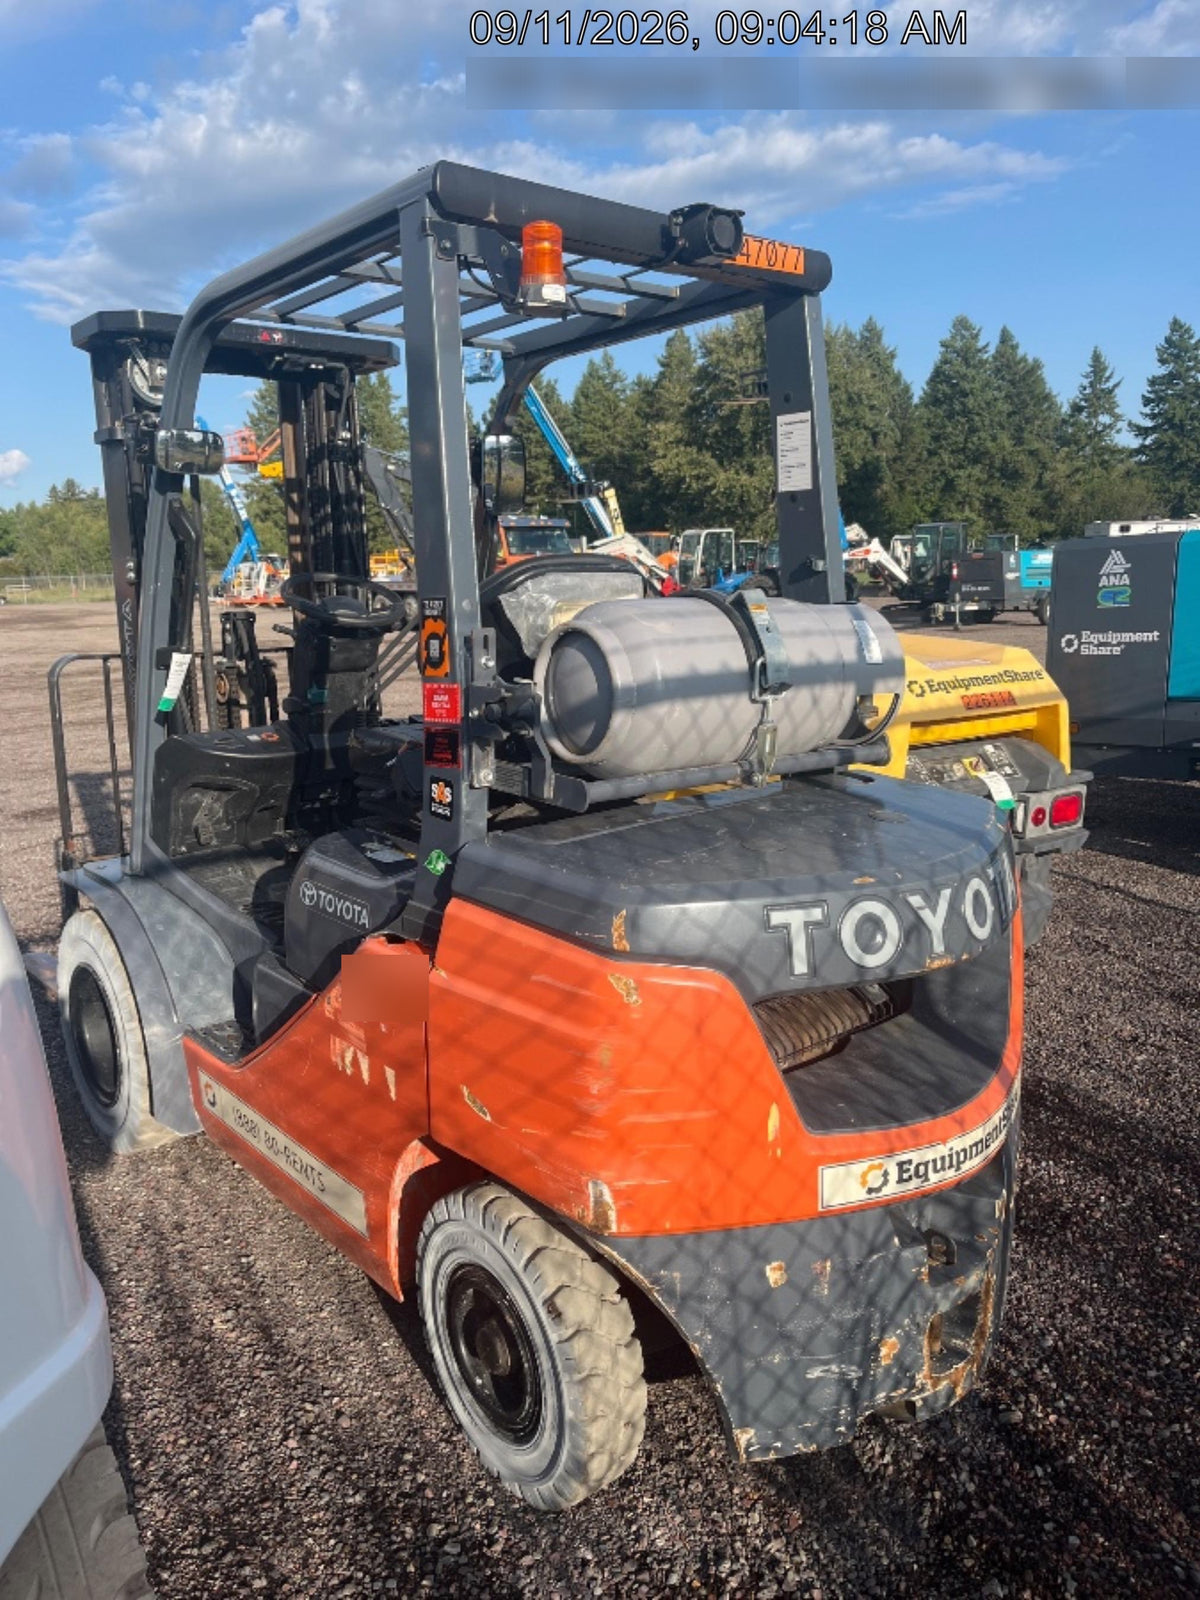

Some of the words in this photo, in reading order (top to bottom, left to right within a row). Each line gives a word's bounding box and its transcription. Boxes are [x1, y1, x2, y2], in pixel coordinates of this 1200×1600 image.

[730, 236, 801, 271] 47077
[1098, 574, 1130, 587] ANA
[1081, 631, 1160, 644] Equipment
[1080, 645, 1121, 655] Share
[926, 670, 1044, 694] EquipmentShare
[318, 890, 369, 929] TOYOTA
[763, 850, 1017, 980] TOYO
